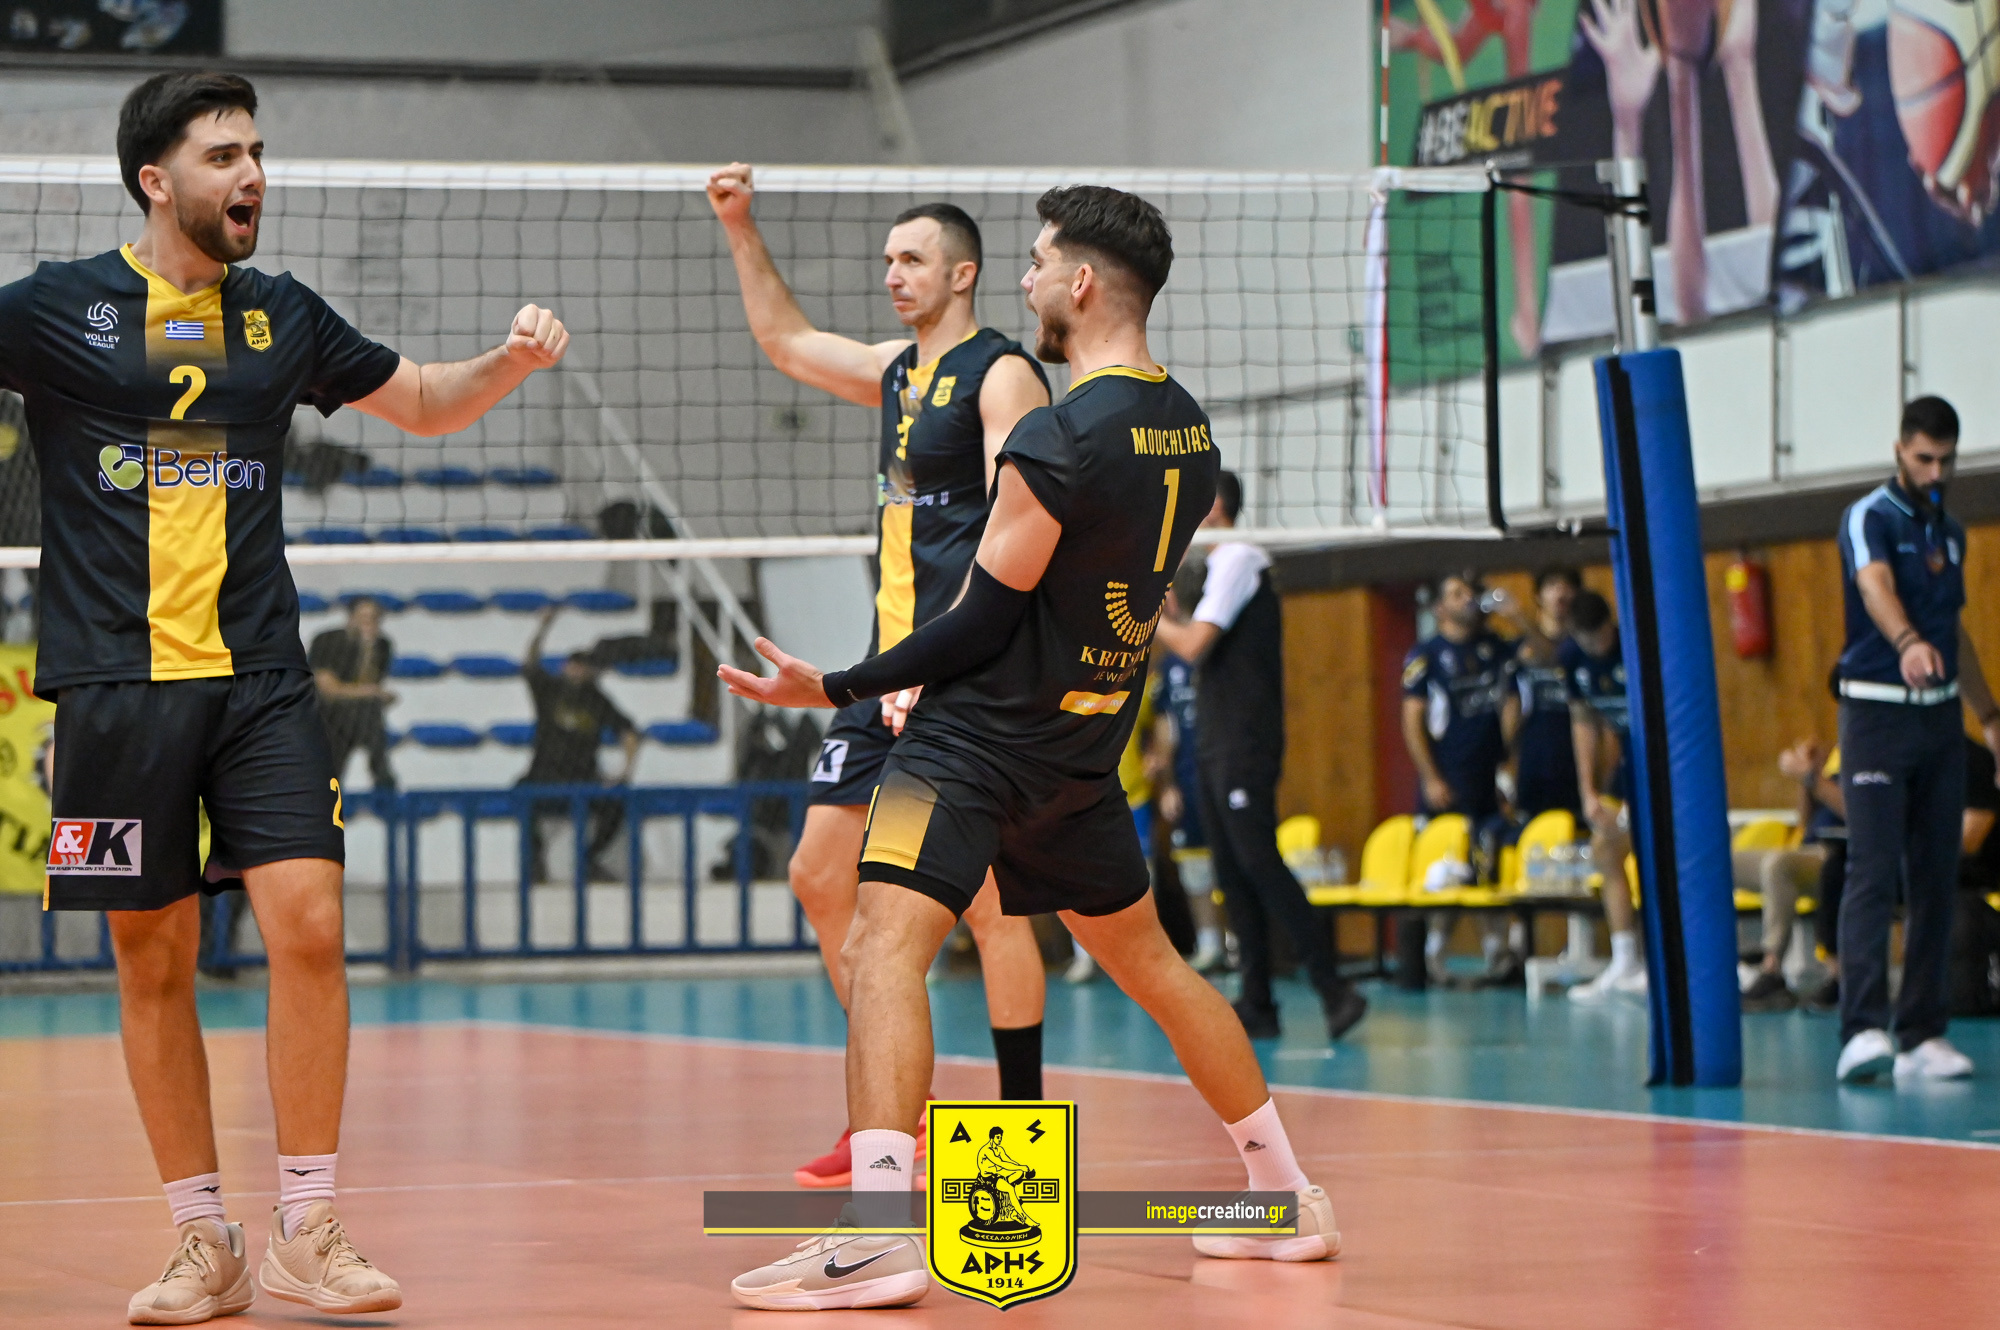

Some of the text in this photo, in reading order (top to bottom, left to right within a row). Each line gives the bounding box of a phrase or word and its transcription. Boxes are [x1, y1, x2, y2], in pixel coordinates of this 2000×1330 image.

[85, 332, 120, 343] VOLLEY
[89, 340, 115, 349] LEAGUE
[169, 365, 206, 421] 2
[1131, 424, 1211, 456] MOUCHLIAS
[1153, 469, 1180, 572] 1
